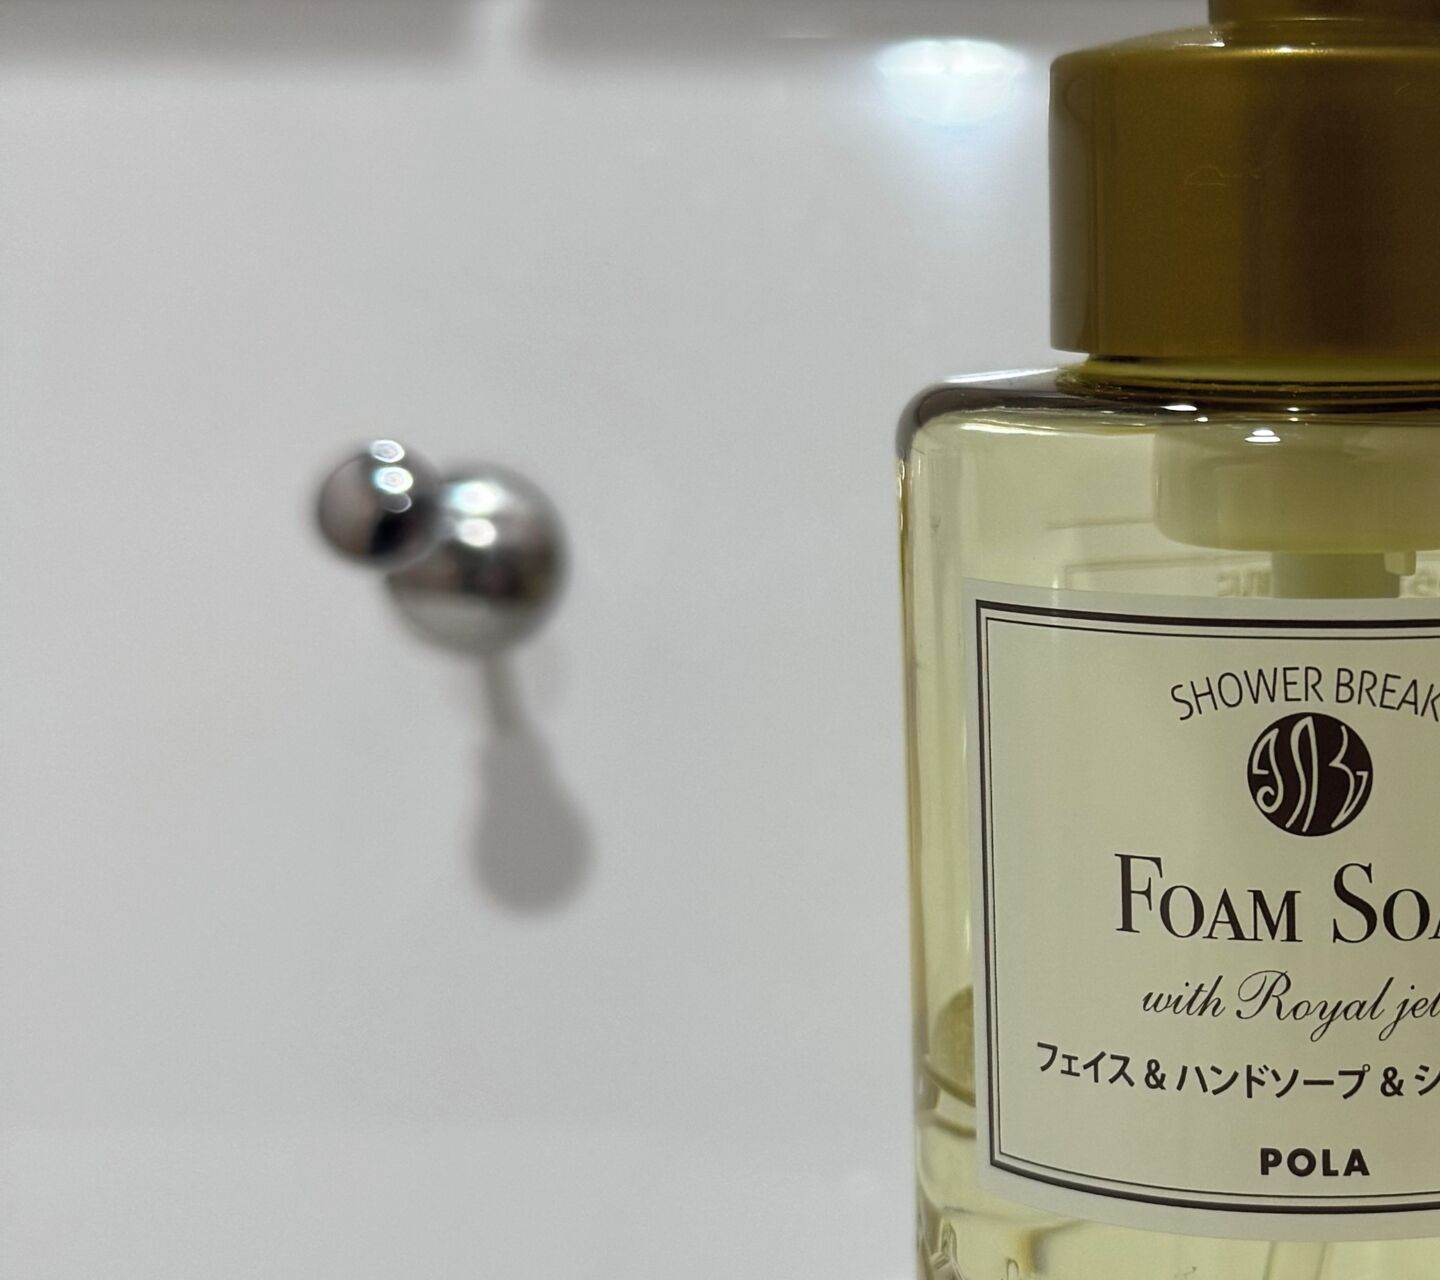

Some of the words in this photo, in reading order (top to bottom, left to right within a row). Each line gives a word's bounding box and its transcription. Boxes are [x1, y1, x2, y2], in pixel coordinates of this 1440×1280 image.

[1170, 666, 1324, 721] SHOWER
[1142, 975, 1226, 1018] with
[1235, 969, 1394, 1042] Royal
[1259, 1148, 1370, 1178] POLA
